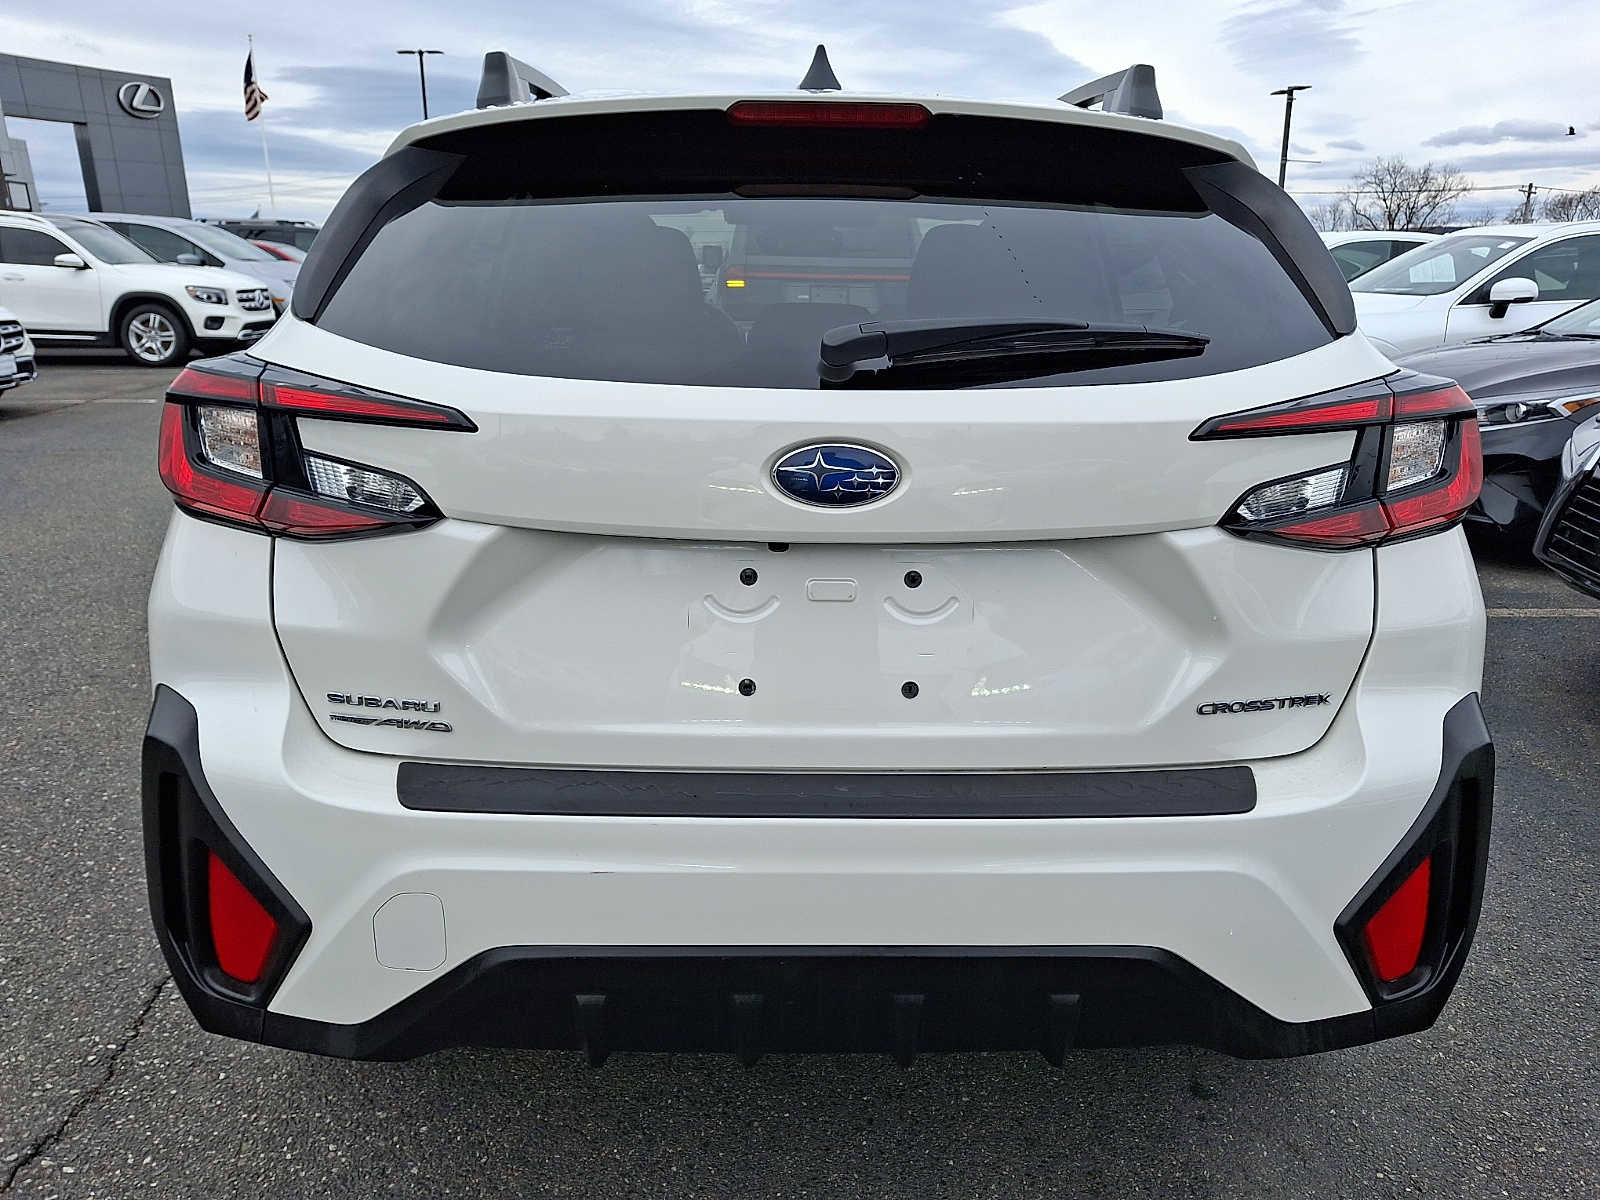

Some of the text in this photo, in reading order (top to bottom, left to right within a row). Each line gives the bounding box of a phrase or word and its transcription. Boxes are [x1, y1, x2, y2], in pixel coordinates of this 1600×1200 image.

[326, 692, 441, 713] SUBARU
[1197, 692, 1331, 715] CROSSTREK
[375, 718, 453, 733] AWD
